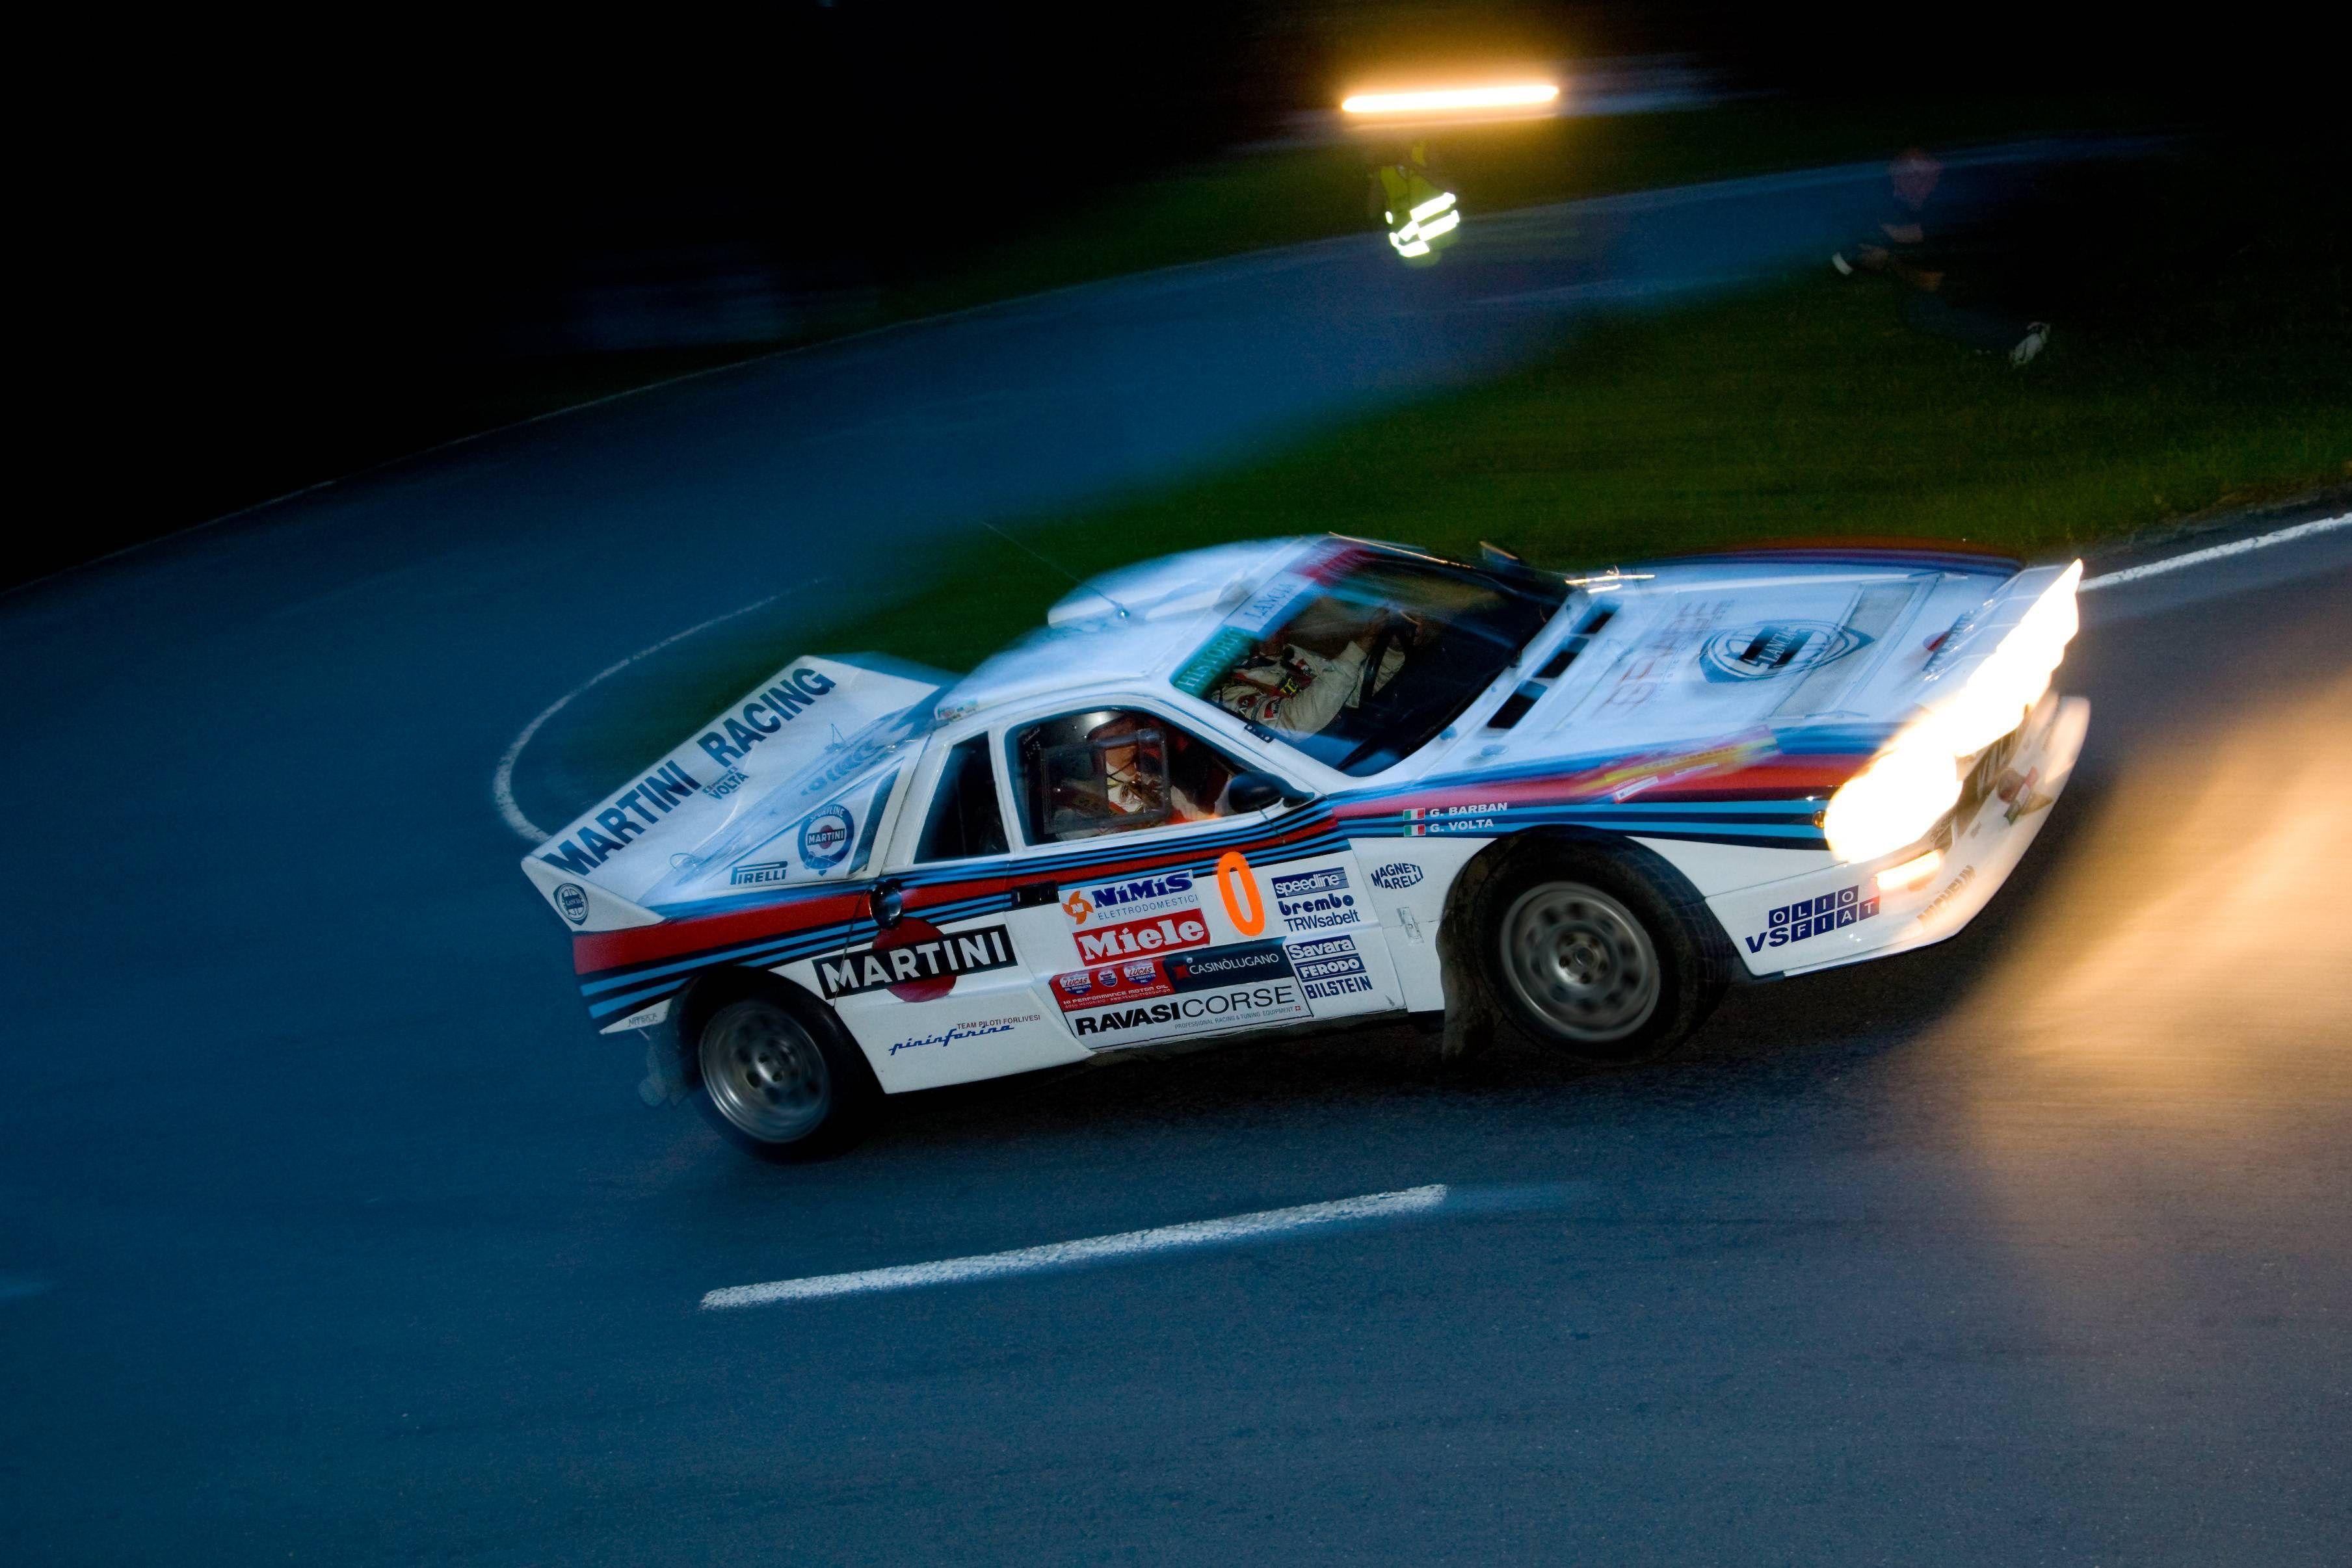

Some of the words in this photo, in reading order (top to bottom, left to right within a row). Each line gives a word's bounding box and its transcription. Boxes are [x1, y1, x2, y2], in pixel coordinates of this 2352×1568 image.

[543, 761, 702, 876] MARTINI
[696, 667, 836, 768] RACING
[709, 772, 749, 800] VOLTA
[1430, 808, 1444, 817] G.
[1449, 802, 1508, 816] BARBAN
[1431, 824, 1444, 832] G.
[1448, 818, 1494, 831] VOLTA
[808, 830, 844, 844] MARTINI
[730, 861, 788, 885] PIRELLI
[1275, 873, 1340, 896] speedline
[1216, 852, 1266, 937] 0
[1278, 893, 1354, 916] brembo
[1098, 894, 1199, 921] ELETTRODOMESTICI
[1773, 891, 1854, 924] OLIO
[1078, 920, 1204, 960] Miele
[1288, 939, 1354, 959] Savara
[823, 932, 1007, 993] MARTINI
[1130, 967, 1152, 976] LUCAS
[1301, 958, 1360, 978] FERODO
[1066, 977, 1088, 987] LUCAS
[1304, 976, 1373, 999] BILSTEIN
[979, 1019, 1001, 1028] PILOTI
[1003, 1014, 1040, 1024] FORLIVESI
[1174, 1018, 1214, 1030] PROFESSIONAL
[1215, 1015, 1235, 1024] RACING
[1240, 1012, 1260, 1021] TUNING
[1262, 1007, 1293, 1017] EQUIPMENT
[889, 1025, 1015, 1056] pininfarina
